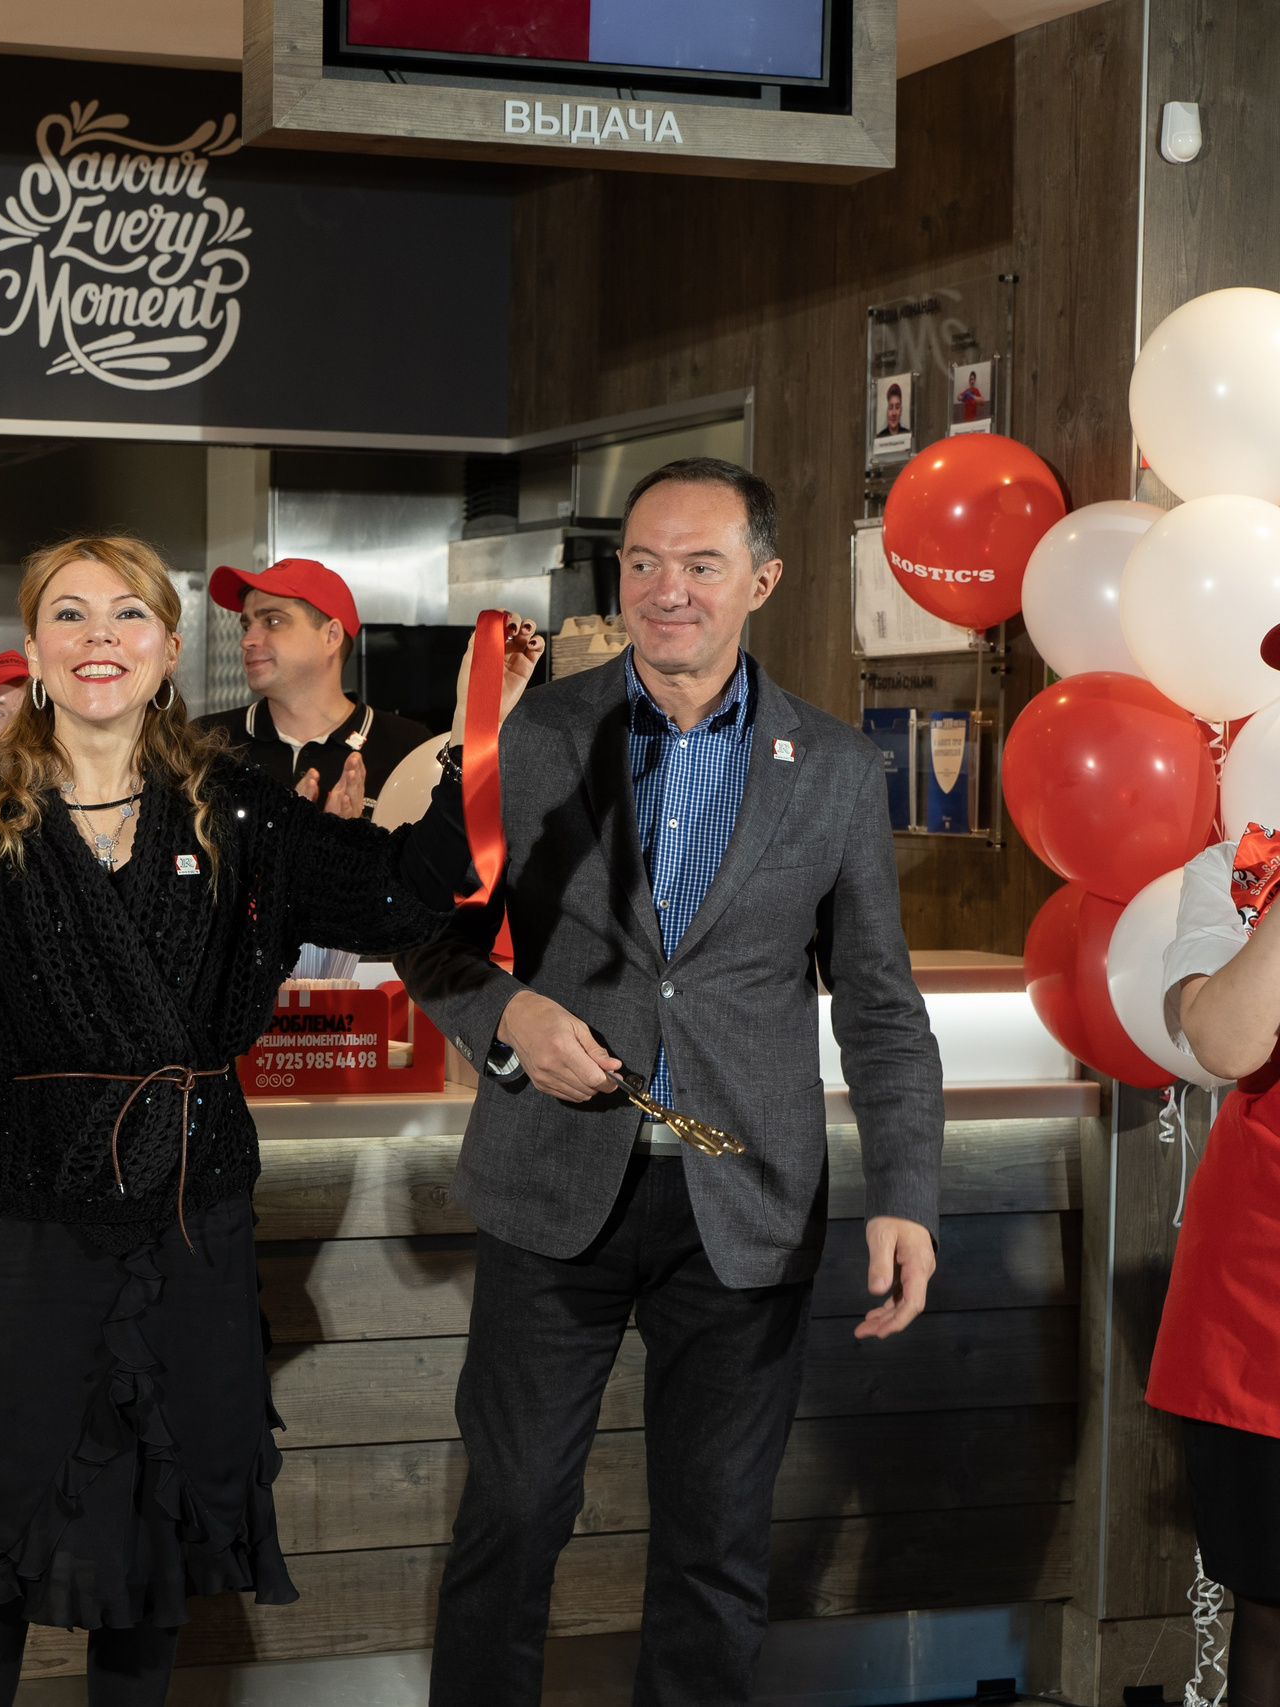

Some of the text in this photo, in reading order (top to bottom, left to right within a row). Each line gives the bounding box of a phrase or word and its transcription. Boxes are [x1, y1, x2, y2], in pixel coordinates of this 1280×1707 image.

[504, 100, 683, 145] ВЫДАЧА
[20, 113, 210, 223] Savour
[49, 194, 210, 286] Every
[890, 550, 996, 583] ROSTIC'S
[256, 1033, 378, 1047] РЕШИМ МОМЕНТАЛЬНО!
[256, 1051, 377, 1070] +7 925 985 44 98
